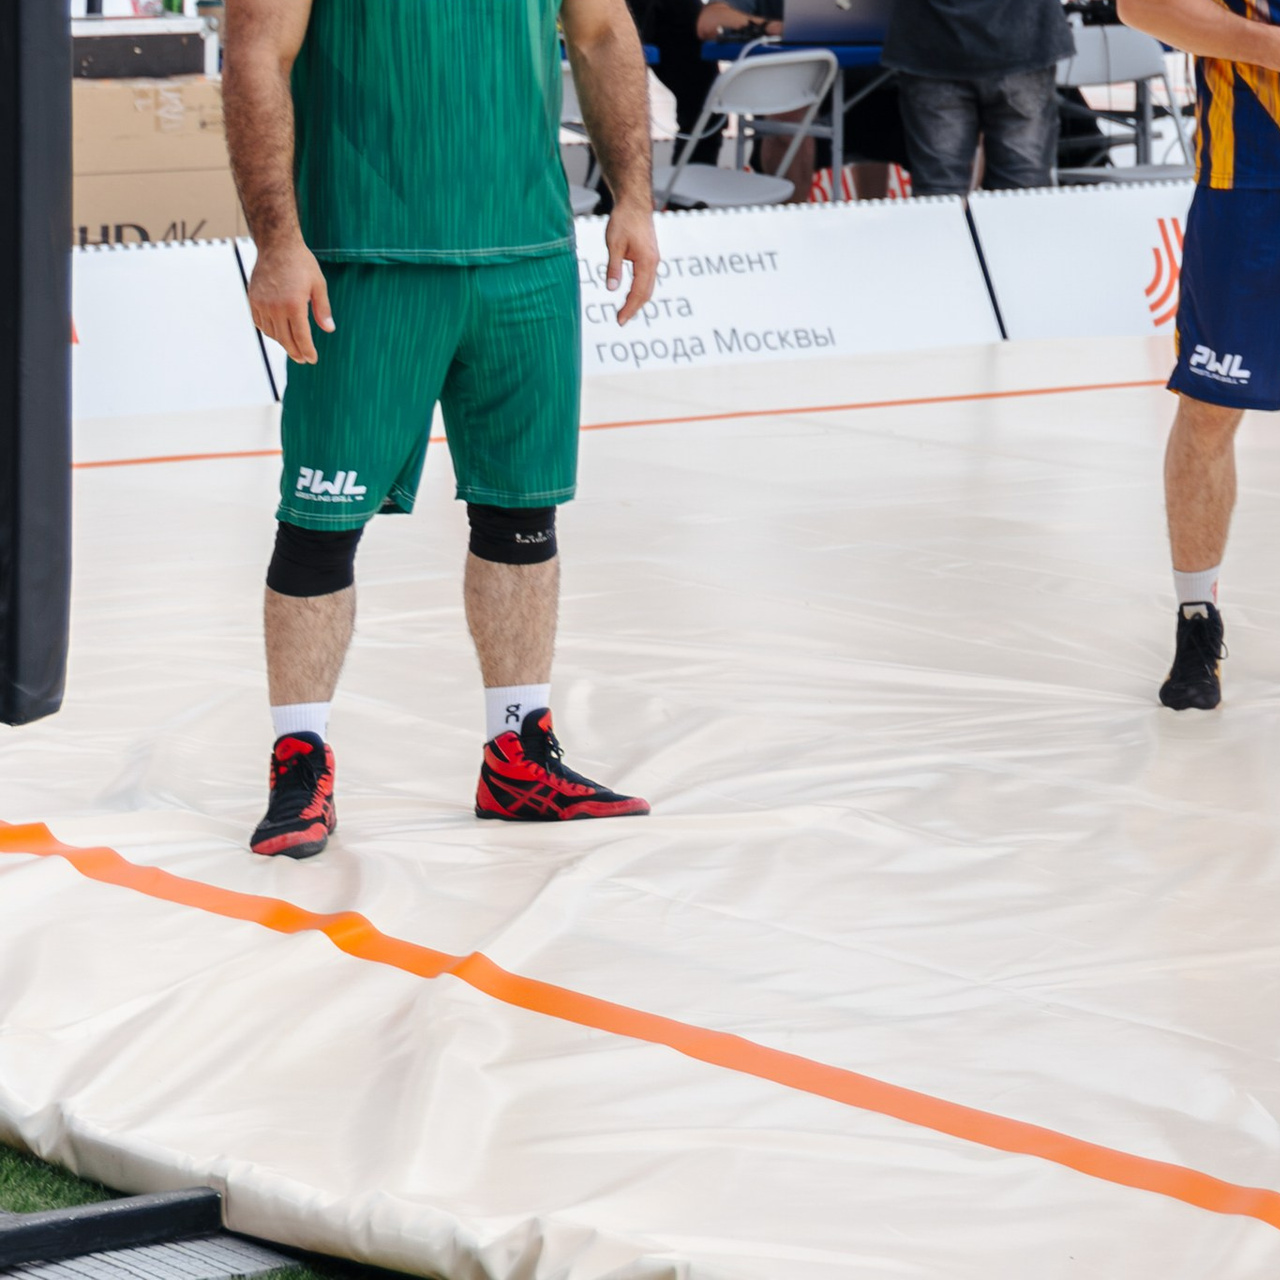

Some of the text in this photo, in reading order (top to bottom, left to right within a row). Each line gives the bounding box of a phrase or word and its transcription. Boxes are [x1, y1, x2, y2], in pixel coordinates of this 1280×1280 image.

[579, 251, 779, 288] Дертамент
[595, 326, 836, 368] города Москвы
[1189, 344, 1251, 378] PWL
[296, 466, 367, 495] PWL
